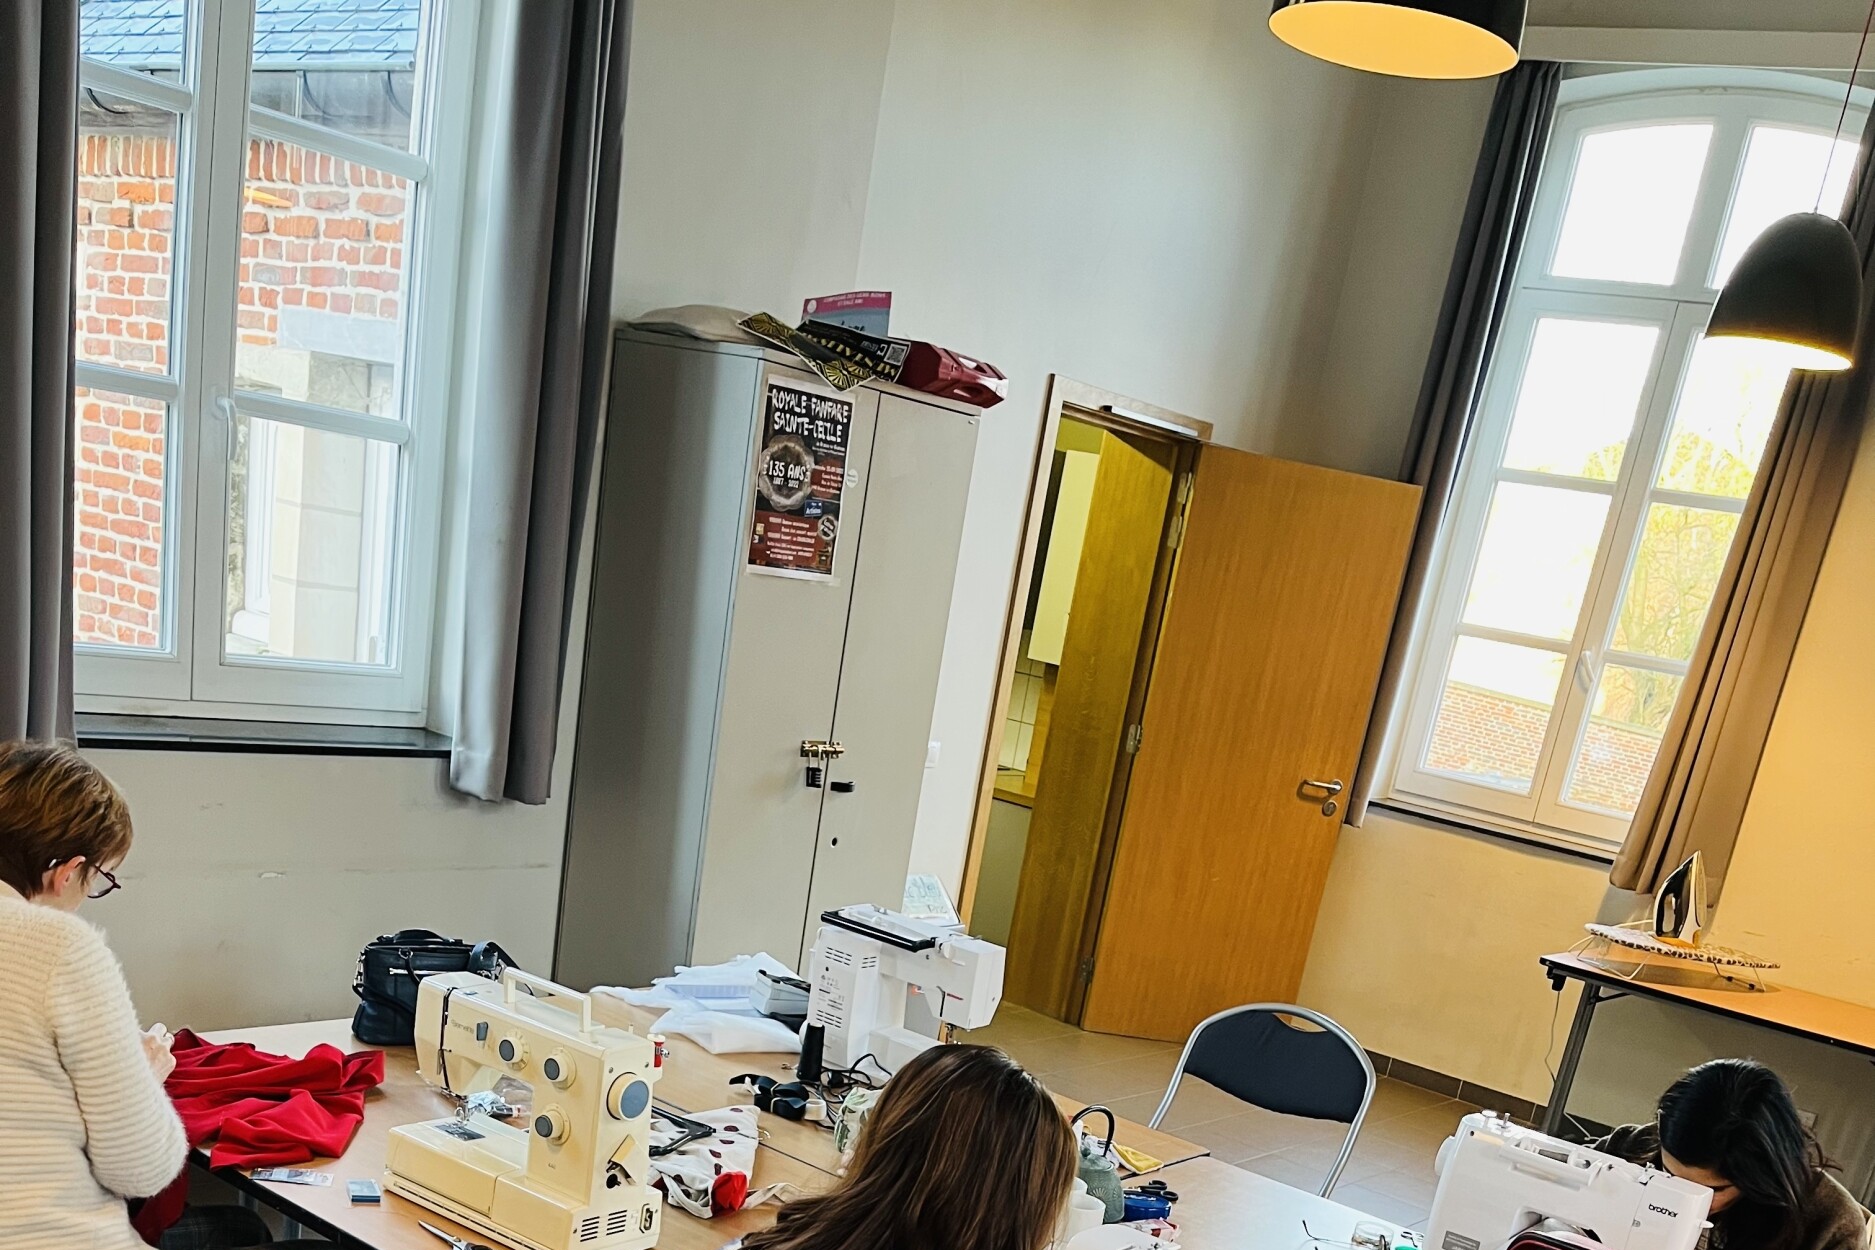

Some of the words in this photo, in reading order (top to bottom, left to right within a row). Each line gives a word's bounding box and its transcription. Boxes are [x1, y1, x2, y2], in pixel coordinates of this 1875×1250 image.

[772, 388, 807, 413] ROYALE
[812, 397, 849, 423] FANFARE
[774, 411, 842, 442] SAINTE-CECILE
[769, 460, 785, 476] 135
[787, 463, 806, 480] ANS
[1648, 1203, 1679, 1218] brother
